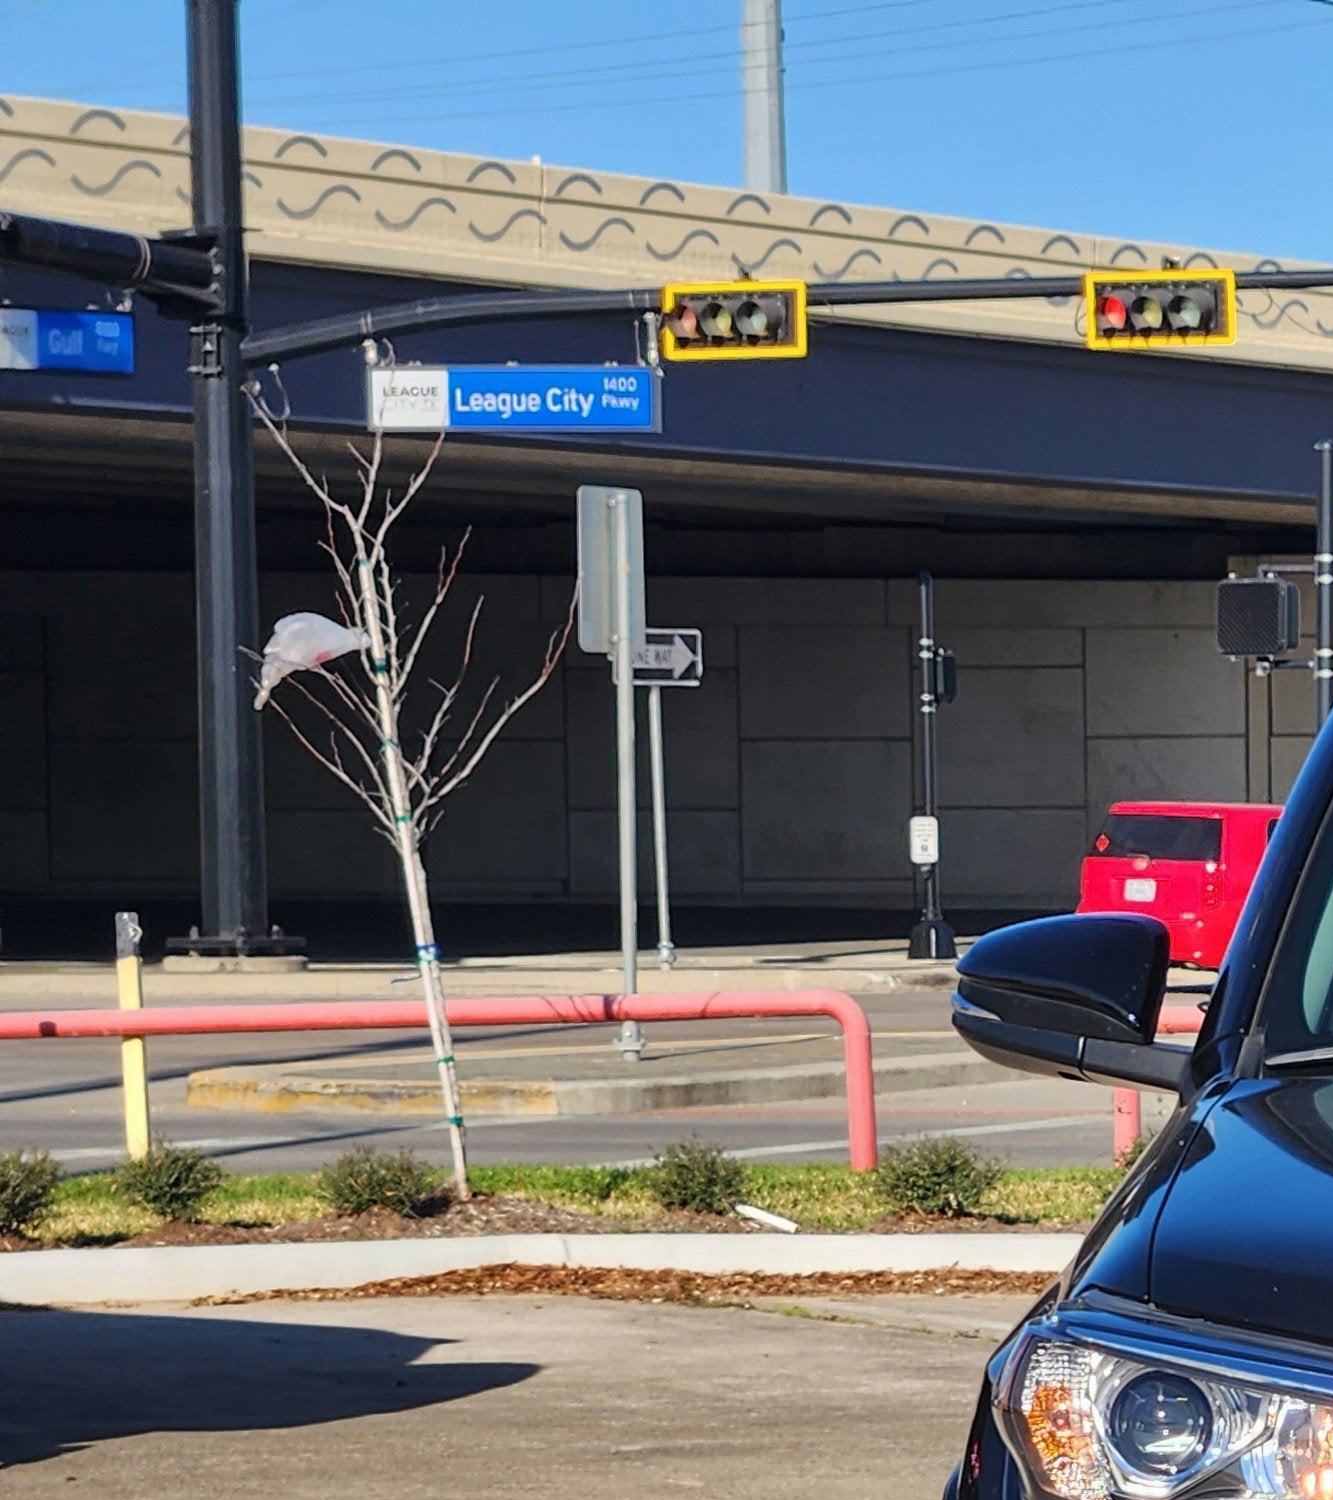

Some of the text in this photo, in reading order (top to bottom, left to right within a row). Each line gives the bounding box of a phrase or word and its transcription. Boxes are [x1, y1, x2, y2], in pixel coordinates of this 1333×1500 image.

[382, 385, 438, 398] LEAGUE
[603, 376, 638, 392] 1400
[455, 386, 595, 419] League City
[601, 392, 640, 412] Pkwy
